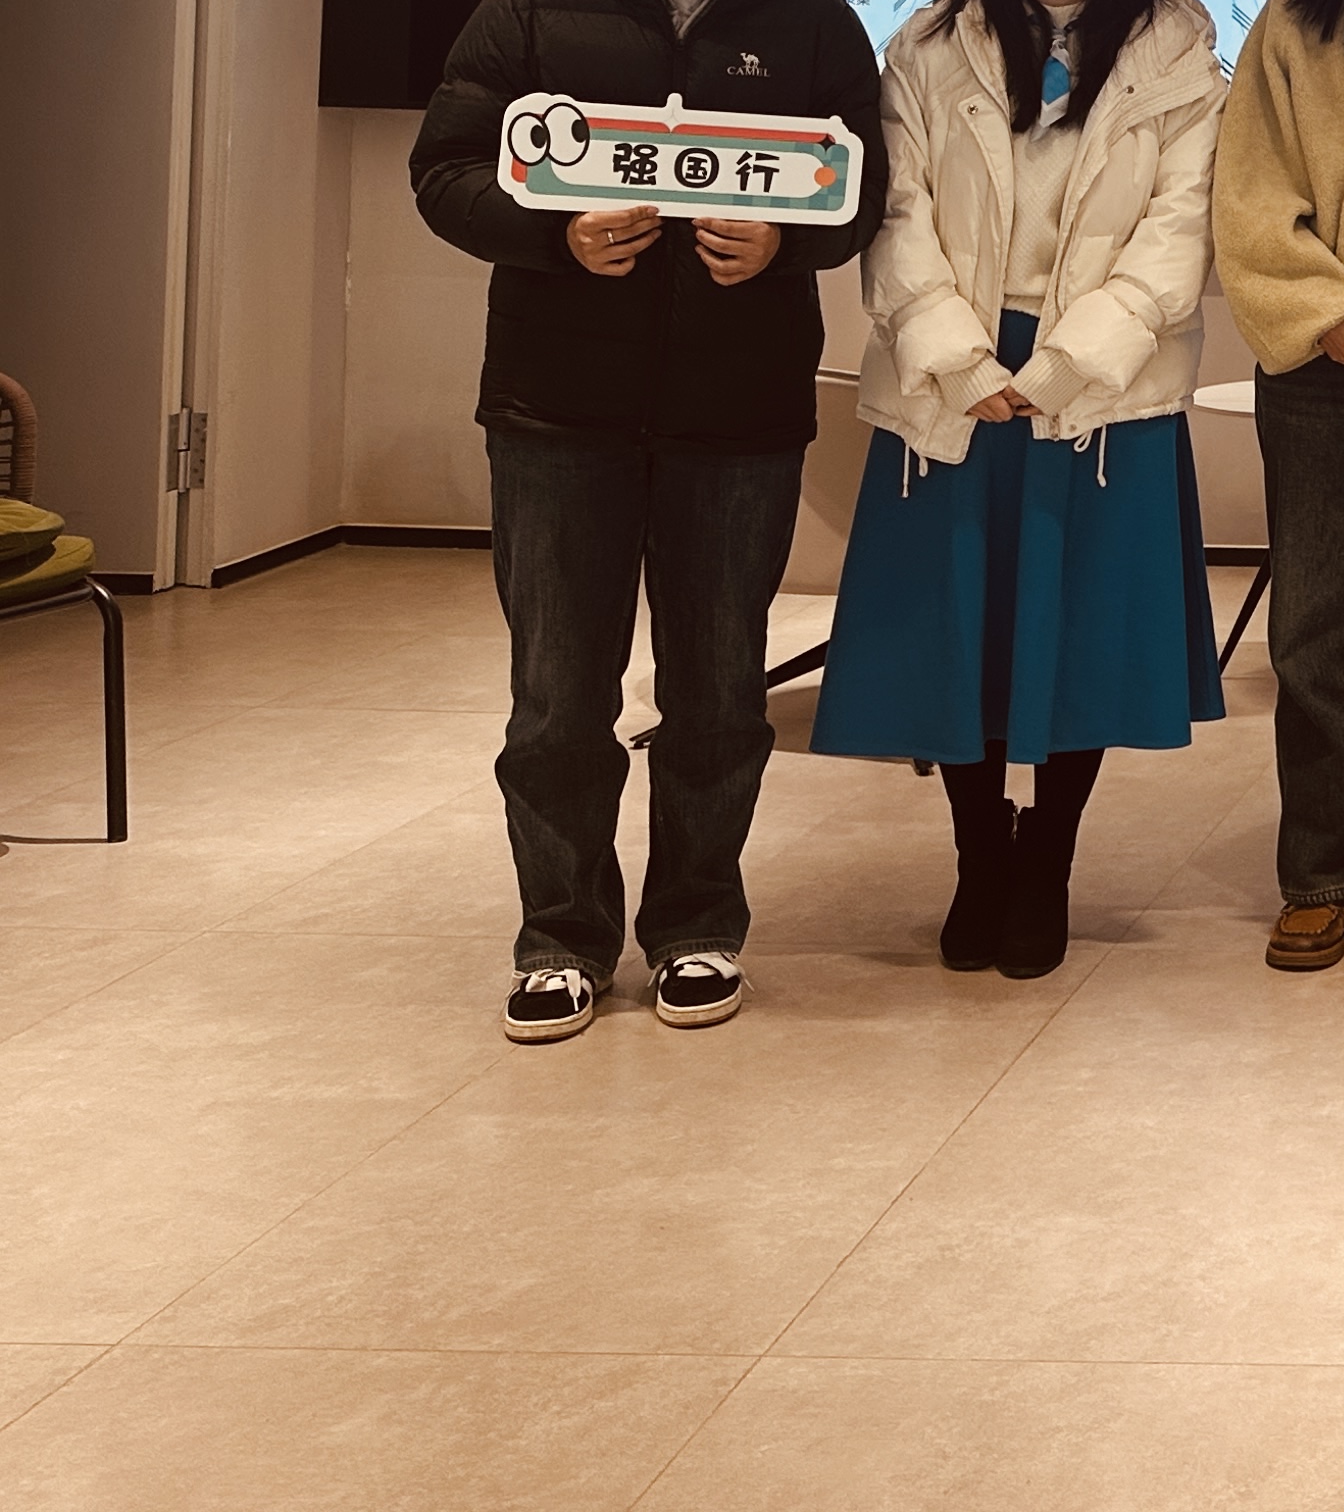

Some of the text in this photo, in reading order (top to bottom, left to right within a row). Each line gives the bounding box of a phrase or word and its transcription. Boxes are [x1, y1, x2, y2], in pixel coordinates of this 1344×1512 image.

[726, 65, 771, 78] CAMEL
[612, 142, 780, 193] 强国行
